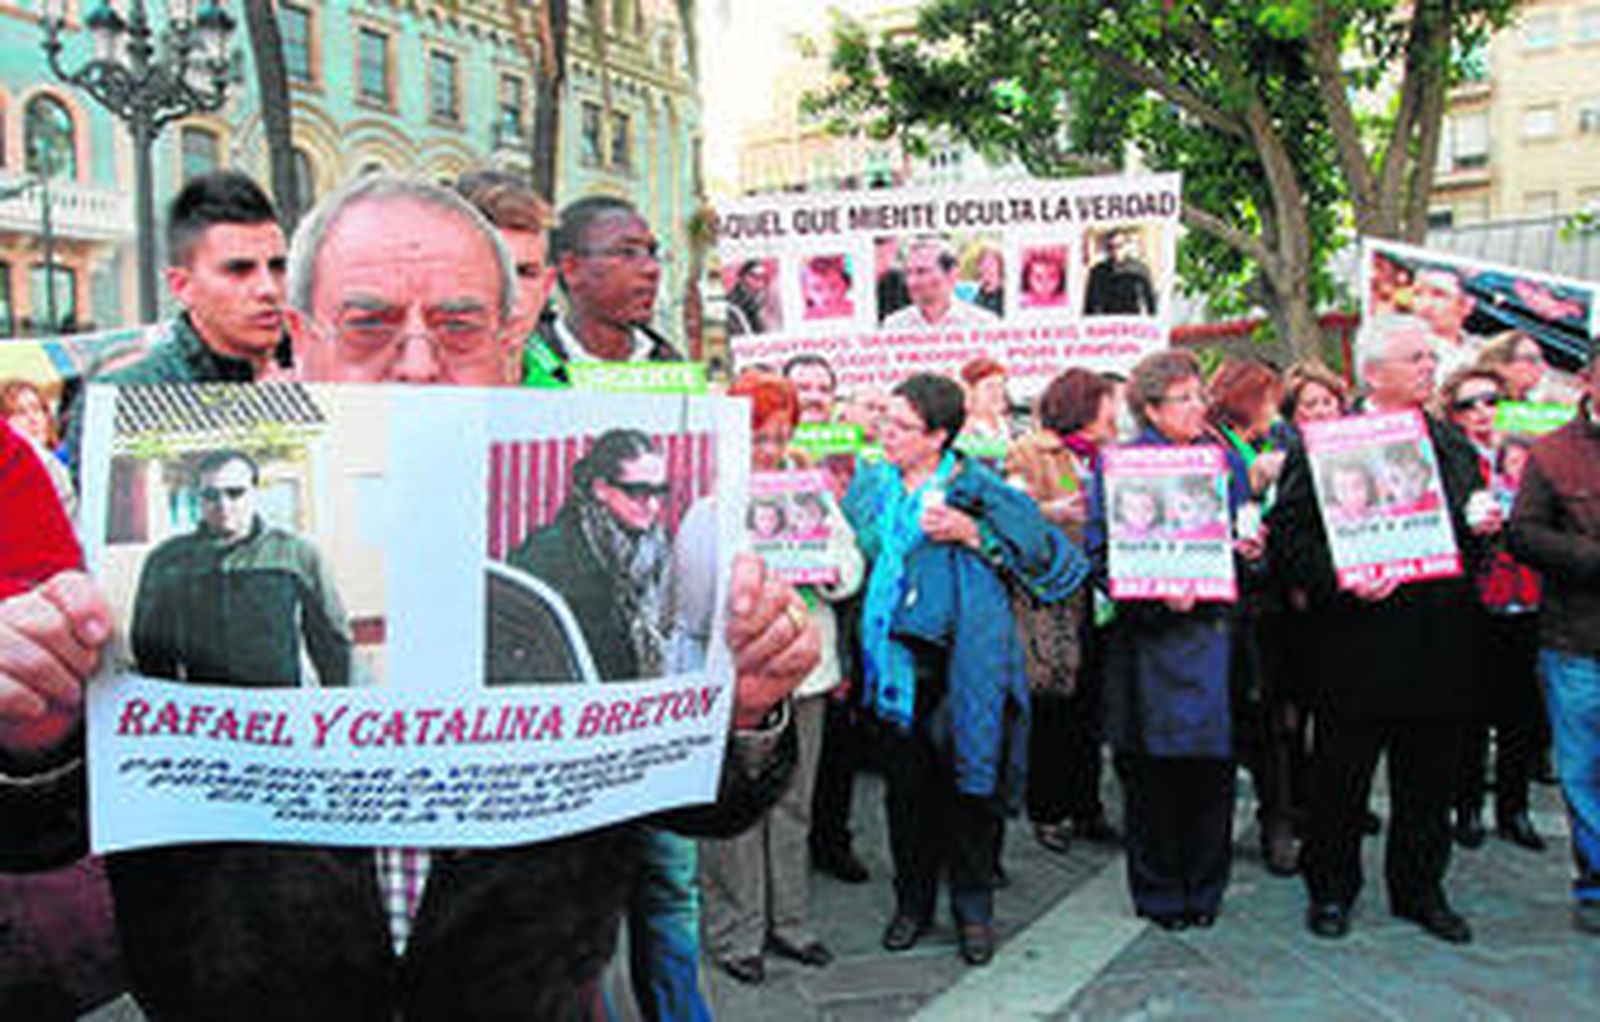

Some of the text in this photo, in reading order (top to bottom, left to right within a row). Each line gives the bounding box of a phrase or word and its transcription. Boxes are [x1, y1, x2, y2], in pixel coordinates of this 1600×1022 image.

[793, 208, 841, 235] QUE
[849, 203, 938, 230] MIENTE
[945, 197, 1036, 226] OCULTA
[1041, 197, 1071, 221] LA
[1076, 191, 1177, 220] VERDAD
[116, 686, 722, 748] RAFAEL Y CATALINA BRETON
